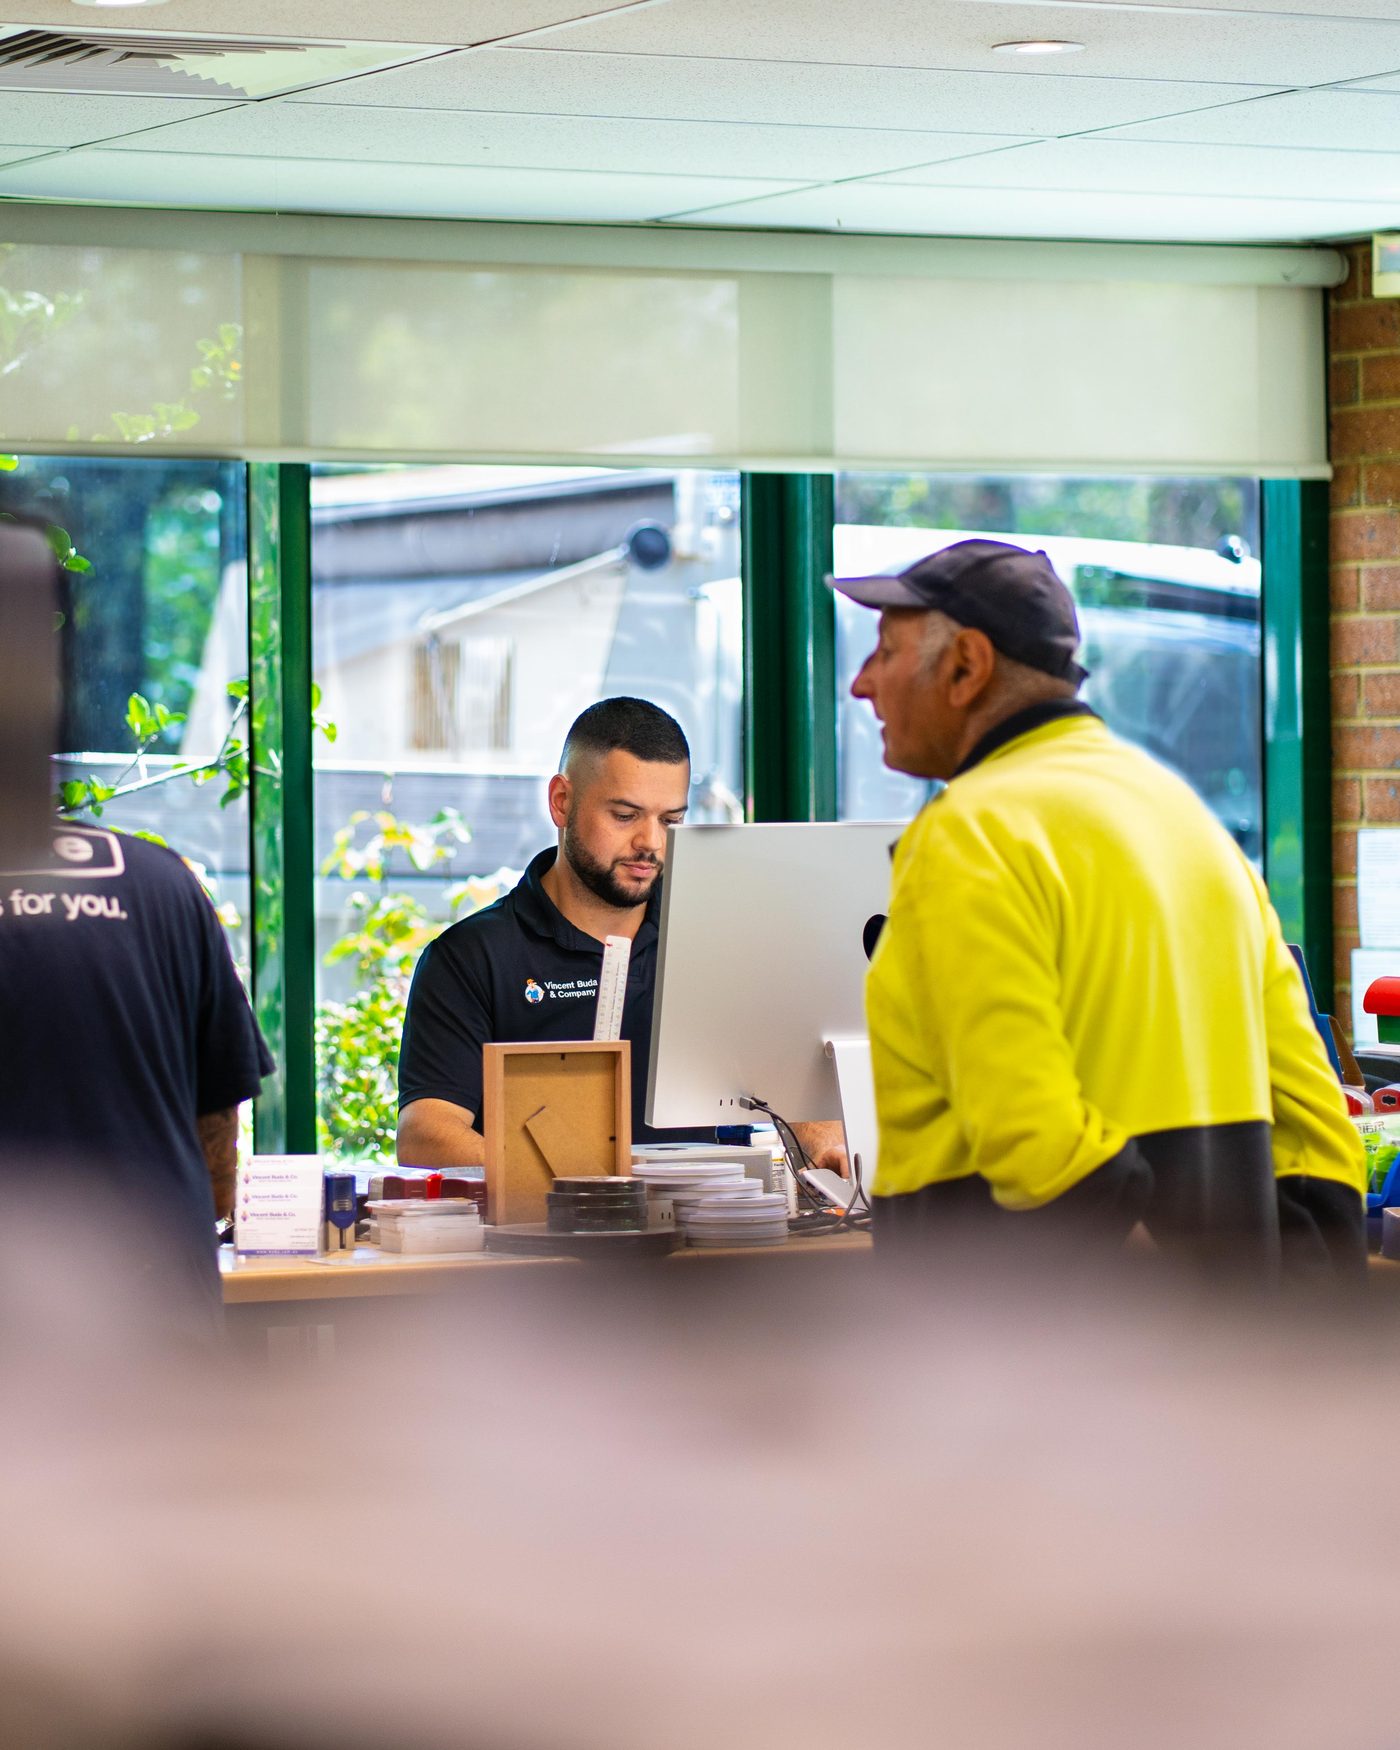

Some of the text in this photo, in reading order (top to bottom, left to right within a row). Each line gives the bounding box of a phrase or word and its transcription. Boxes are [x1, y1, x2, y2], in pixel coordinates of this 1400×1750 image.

[9, 889, 56, 916] for
[61, 893, 128, 921] you.
[544, 979, 598, 990] Vincent Buda
[550, 989, 596, 998] & Company
